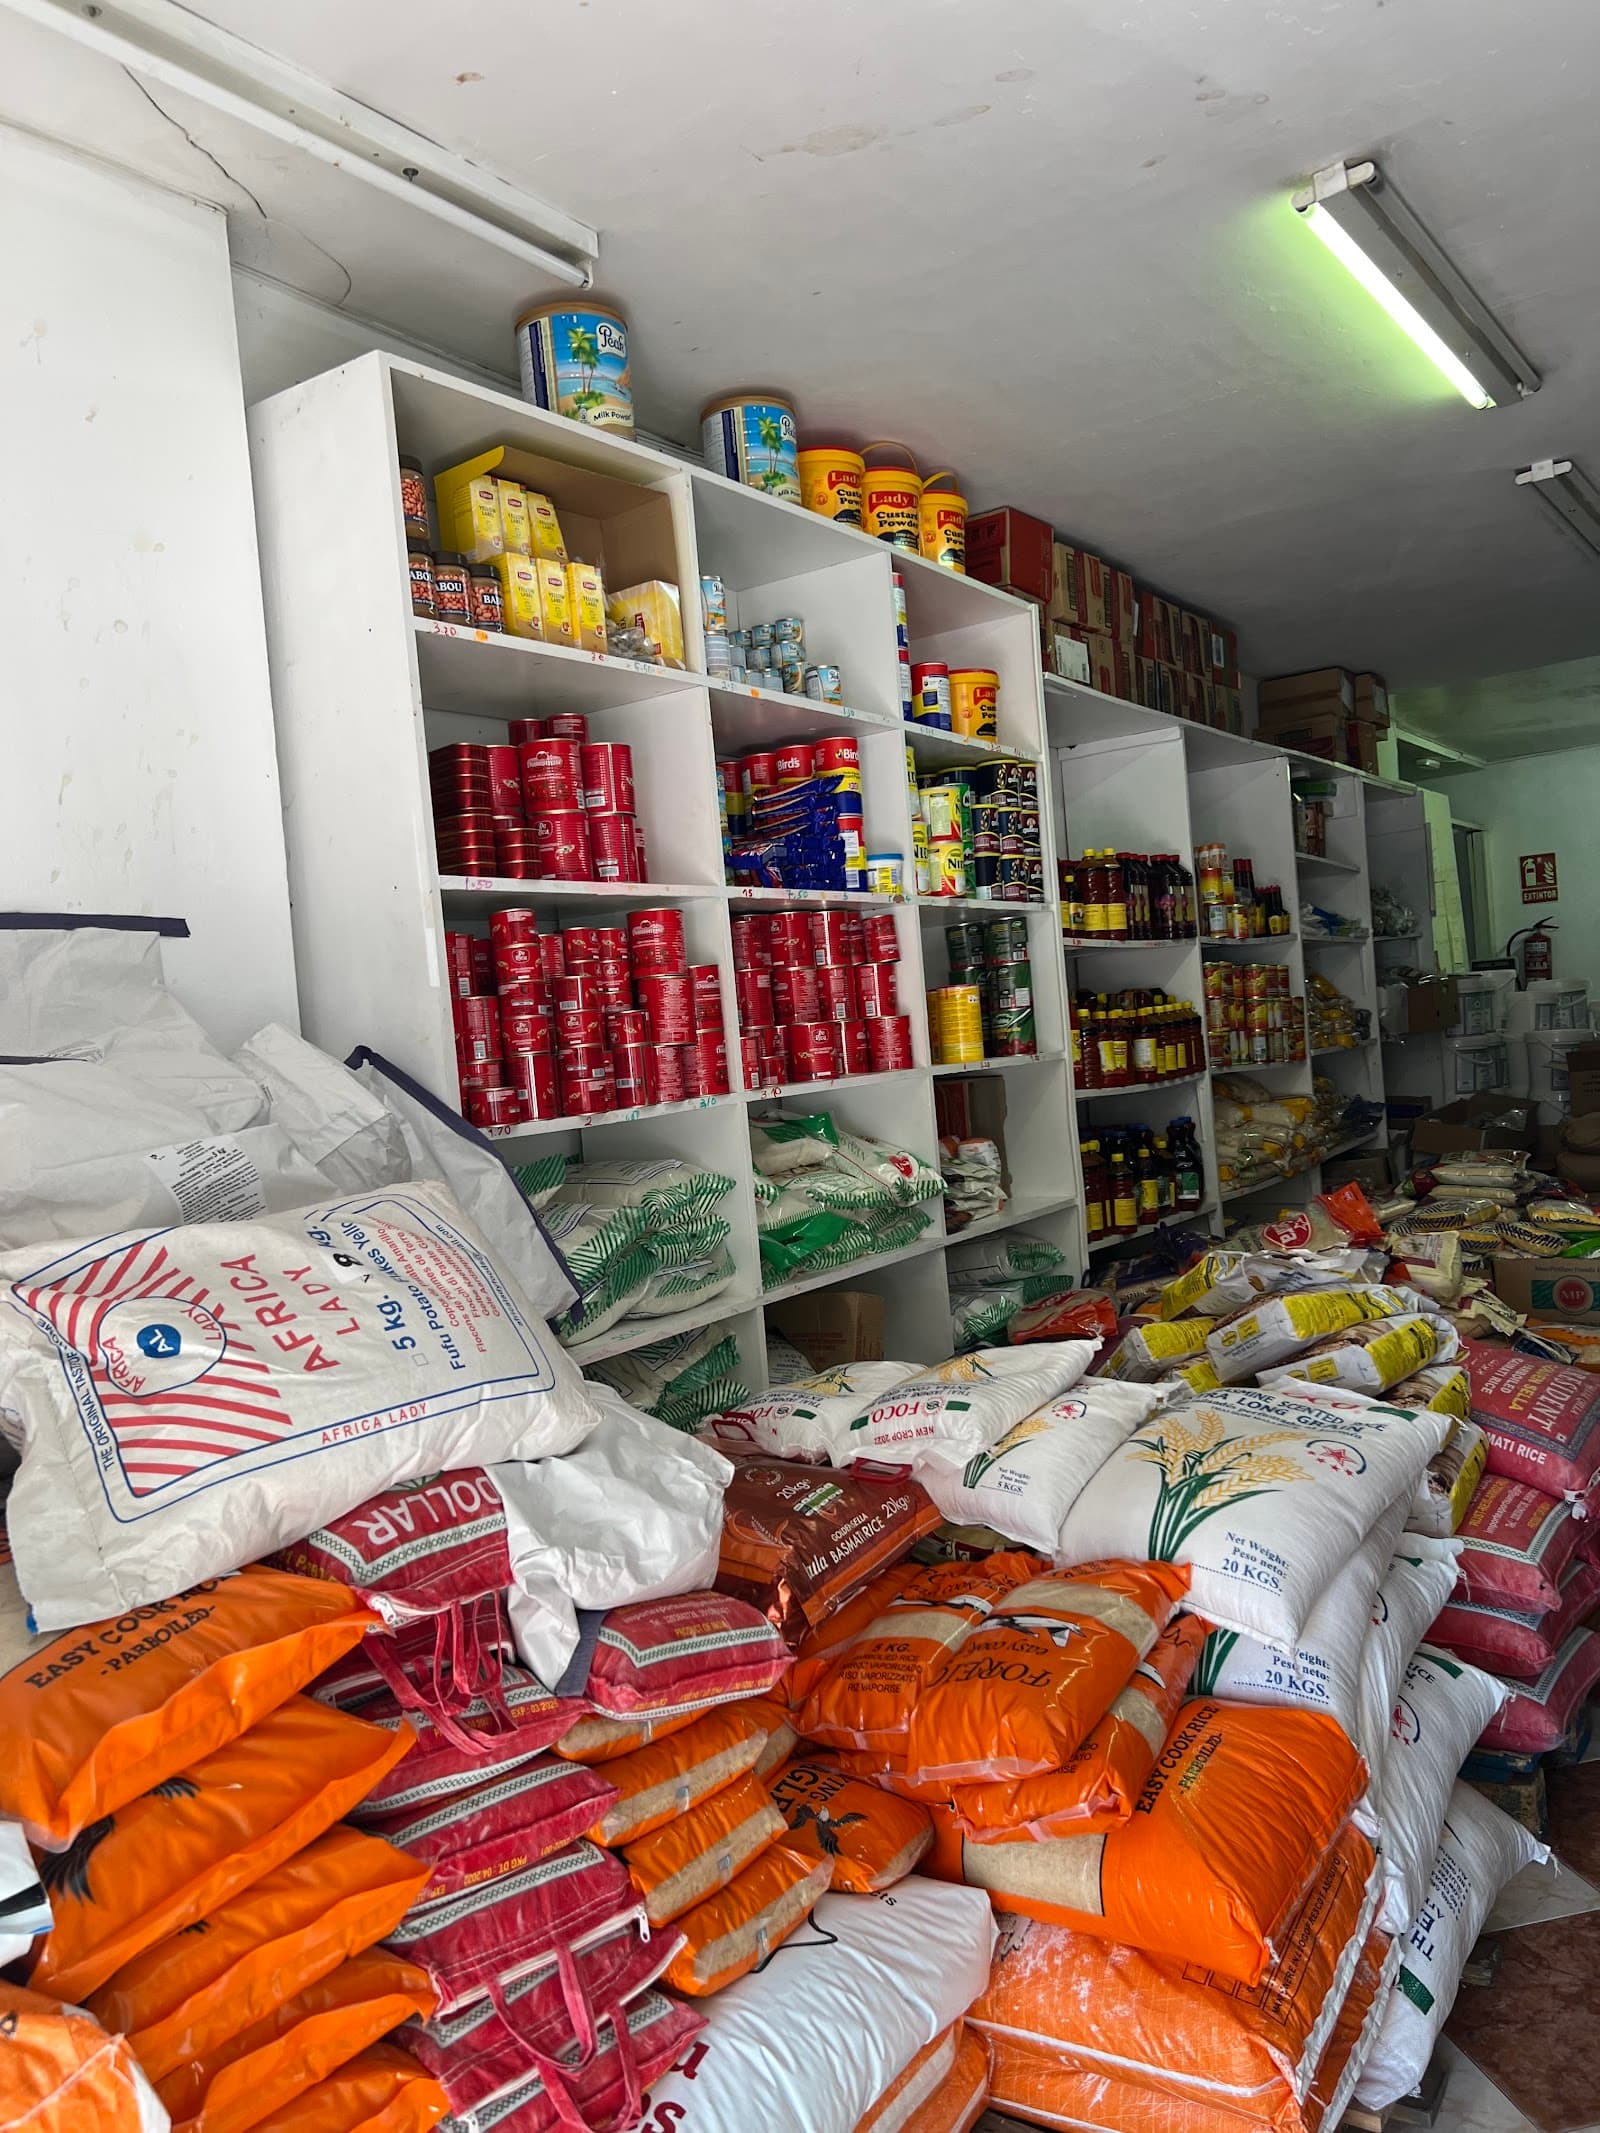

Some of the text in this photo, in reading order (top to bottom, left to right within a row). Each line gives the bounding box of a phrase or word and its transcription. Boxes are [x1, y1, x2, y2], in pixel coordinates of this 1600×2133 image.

[598, 324, 625, 352] Peak
[593, 411, 610, 421] Milk
[1523, 889, 1557, 901] EXTINTOR
[220, 1254, 341, 1372] AFRICA
[283, 1265, 361, 1336] LADY
[408, 1285, 444, 1331] Potato
[180, 1307, 222, 1341] LADY
[376, 1294, 417, 1350] 5 kg.
[148, 1328, 175, 1353] AL
[440, 1334, 466, 1370] Fufu
[102, 1336, 146, 1393] AFRICA
[81, 1392, 110, 1445] ORIGINAL
[872, 1401, 920, 1424] FOCO
[1237, 1397, 1285, 1417] LONG
[1277, 1399, 1344, 1425] SCENTED
[321, 1402, 428, 1444] AFRICA LADY
[892, 1428, 913, 1440] CROP
[915, 1425, 934, 1438] NEW
[100, 1446, 115, 1472] THE
[1516, 1445, 1548, 1465] RICE
[352, 1476, 503, 1546] DOLLAR
[863, 1515, 886, 1540] RICE
[1225, 1531, 1290, 1570] Net Weight:
[1232, 1546, 1288, 1579] Peso neto:
[1221, 1557, 1283, 1592] 20 KGS.
[24, 1640, 101, 1689] EASY
[1297, 1648, 1331, 1670] eight:
[1302, 1665, 1330, 1682] neto:
[1265, 1669, 1331, 1699] 20 KGS.
[1135, 1704, 1220, 1815] EASY COOK RICE
[510, 1855, 528, 1869] PKG
